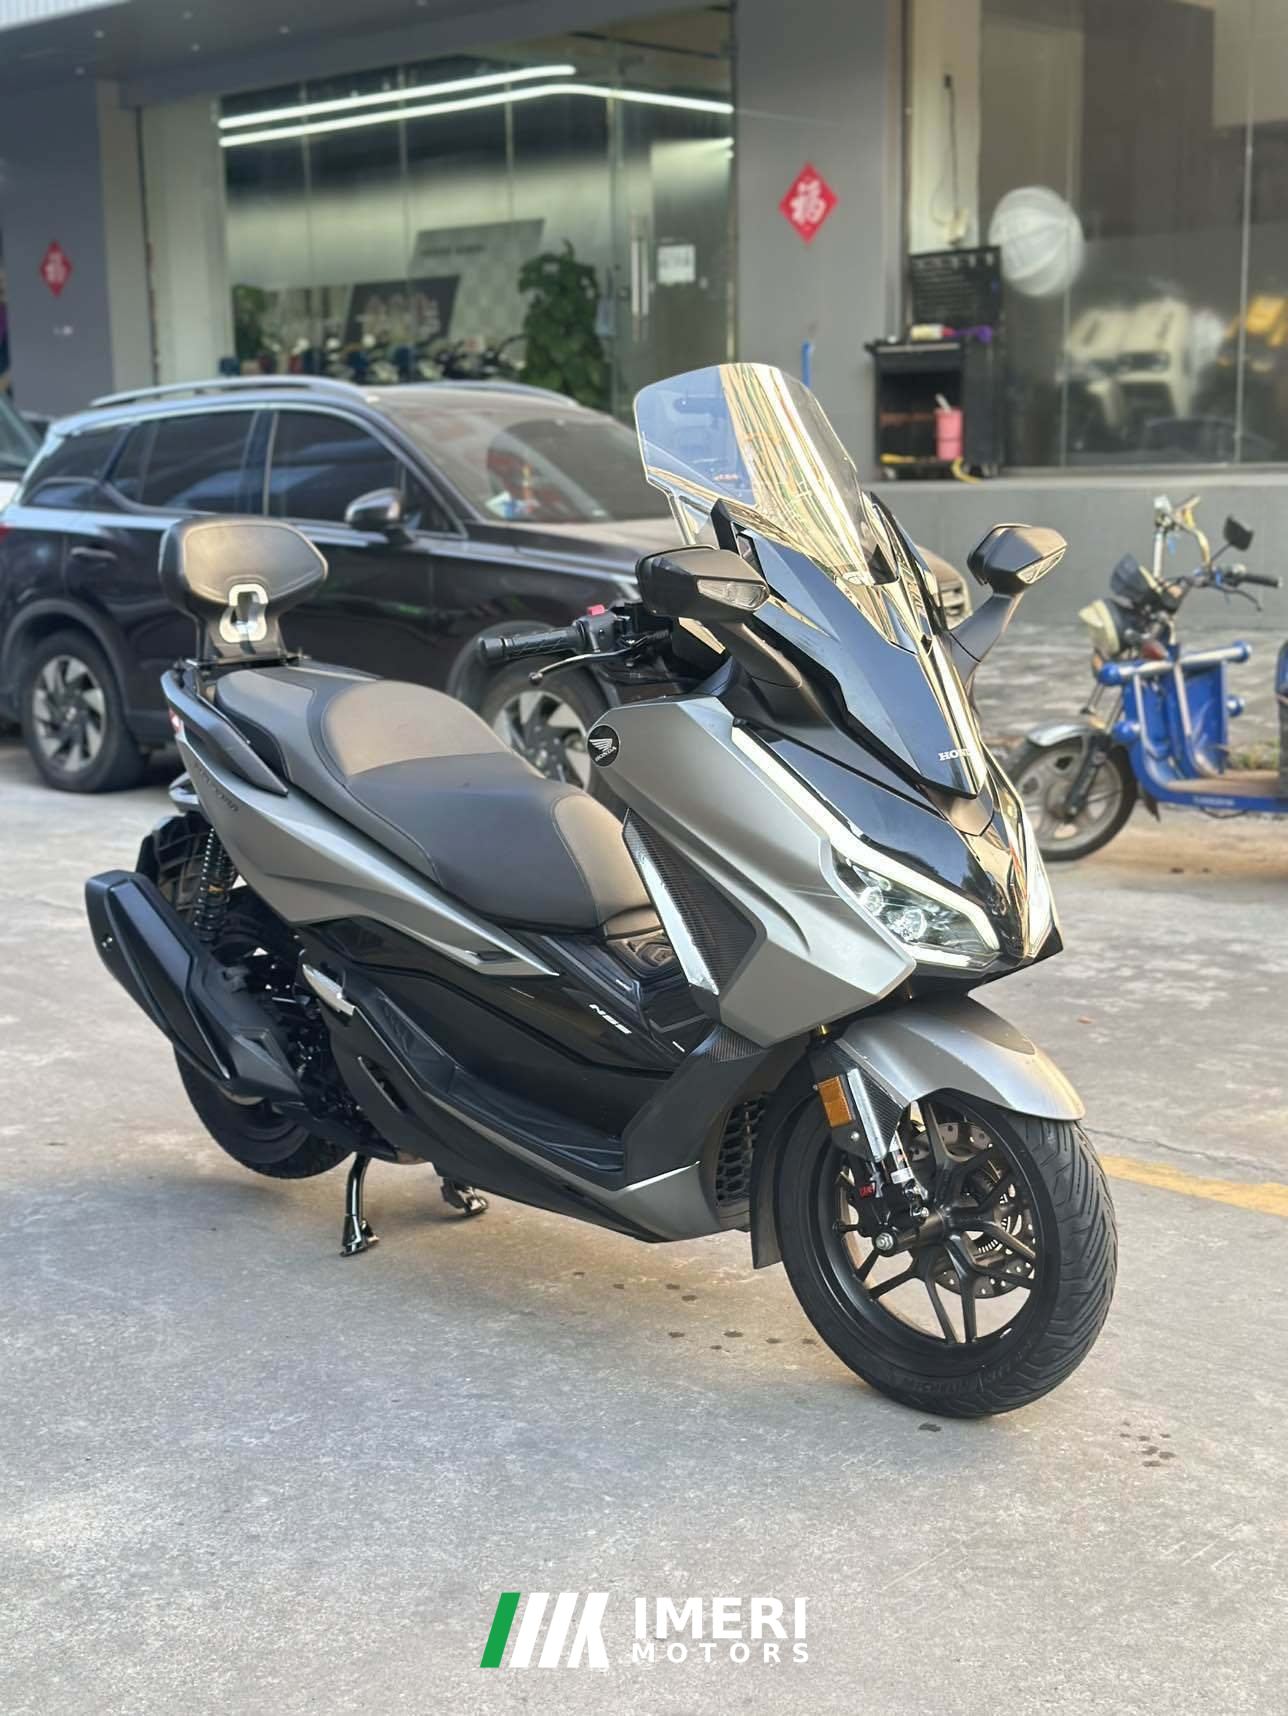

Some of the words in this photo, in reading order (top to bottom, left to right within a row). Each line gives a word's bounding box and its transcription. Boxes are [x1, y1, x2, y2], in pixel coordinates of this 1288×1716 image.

[790, 179, 826, 224] 福
[595, 746, 617, 762] HONDA
[589, 1004, 633, 1034] NSS
